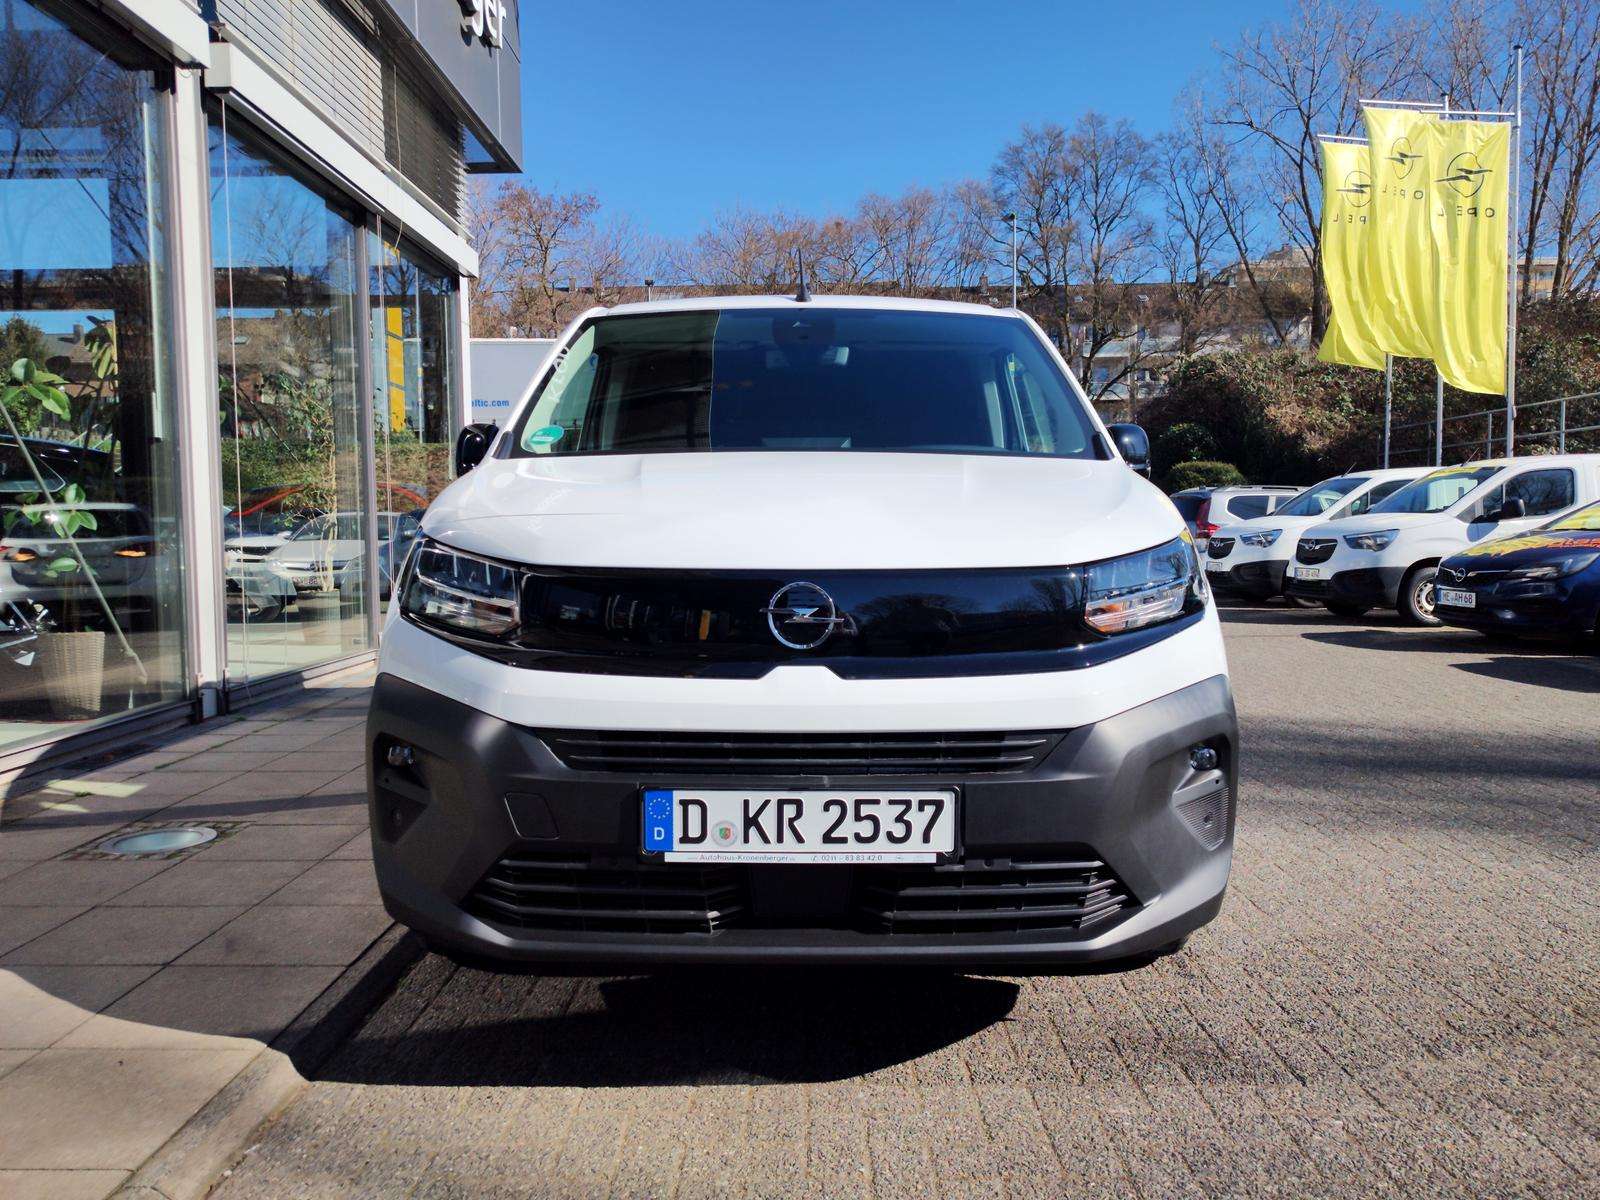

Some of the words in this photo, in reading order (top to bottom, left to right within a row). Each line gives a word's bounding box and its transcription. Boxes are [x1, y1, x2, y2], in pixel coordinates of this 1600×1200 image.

[653, 826, 665, 841] D
[678, 798, 708, 845] D
[742, 798, 806, 845] KR
[821, 798, 946, 845] 2537
